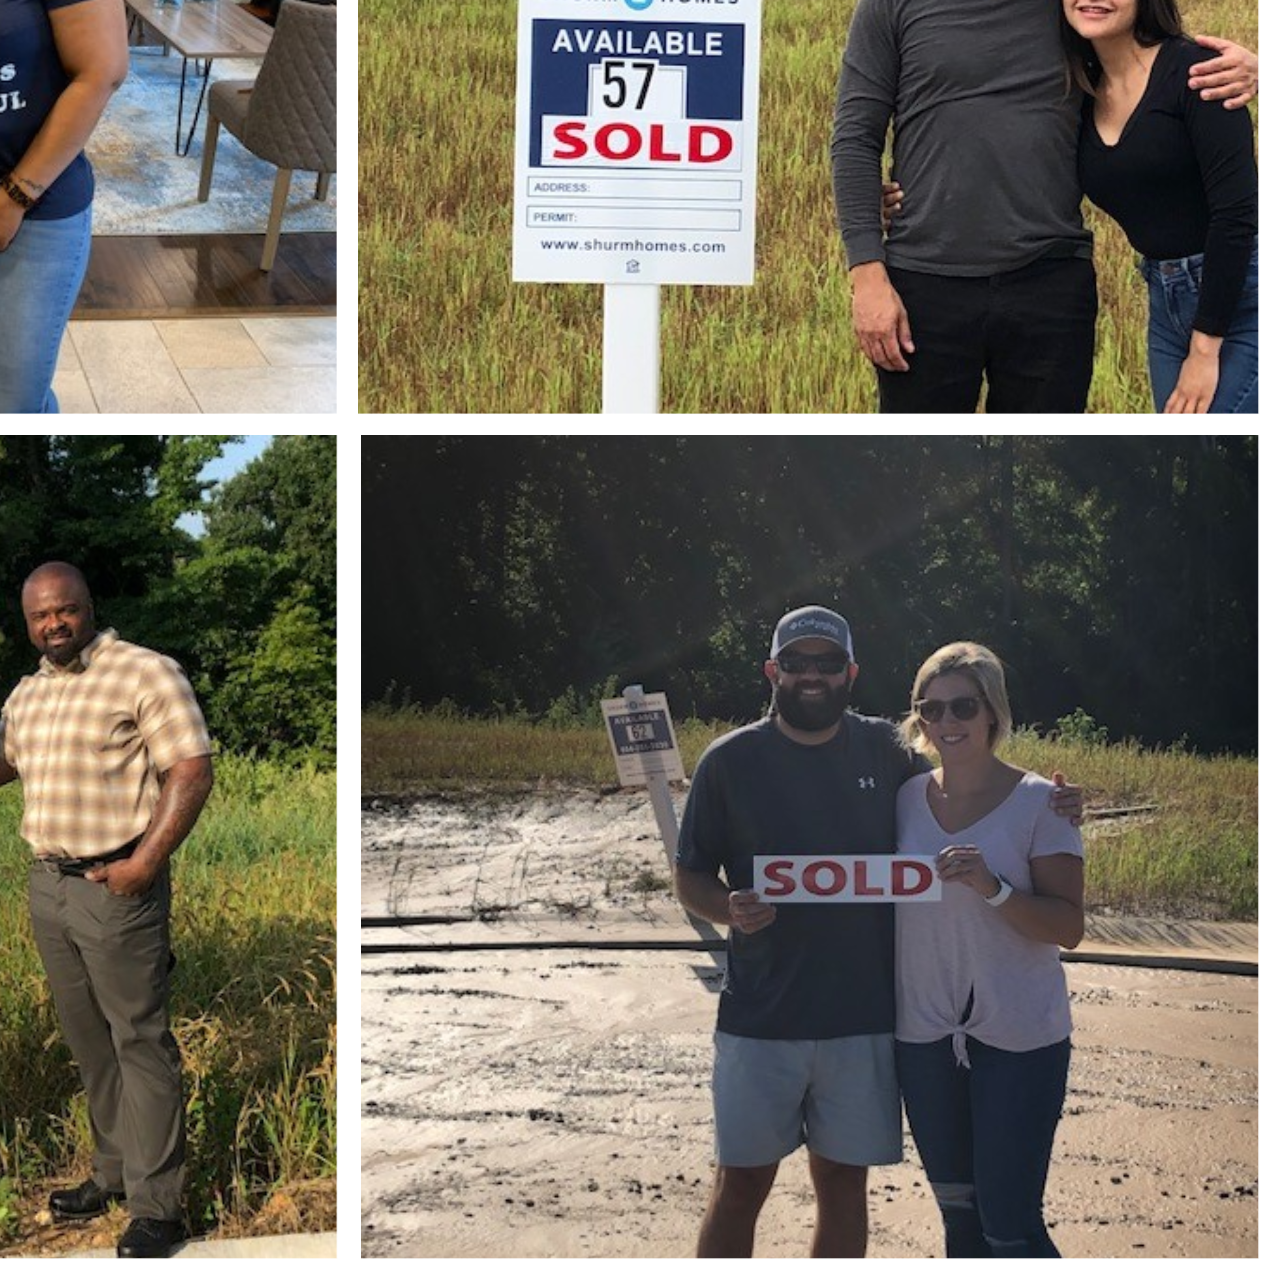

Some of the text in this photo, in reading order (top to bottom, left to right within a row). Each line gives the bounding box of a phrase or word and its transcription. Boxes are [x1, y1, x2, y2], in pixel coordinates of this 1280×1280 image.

[552, 29, 723, 56] AVAILABLE
[602, 61, 655, 110] 57
[553, 122, 732, 163] SOLD
[534, 182, 590, 193] ADDRESS:
[533, 212, 577, 222] PERMIT:
[540, 238, 726, 253] www.shurmhomes.com
[763, 860, 933, 896] SOLD
